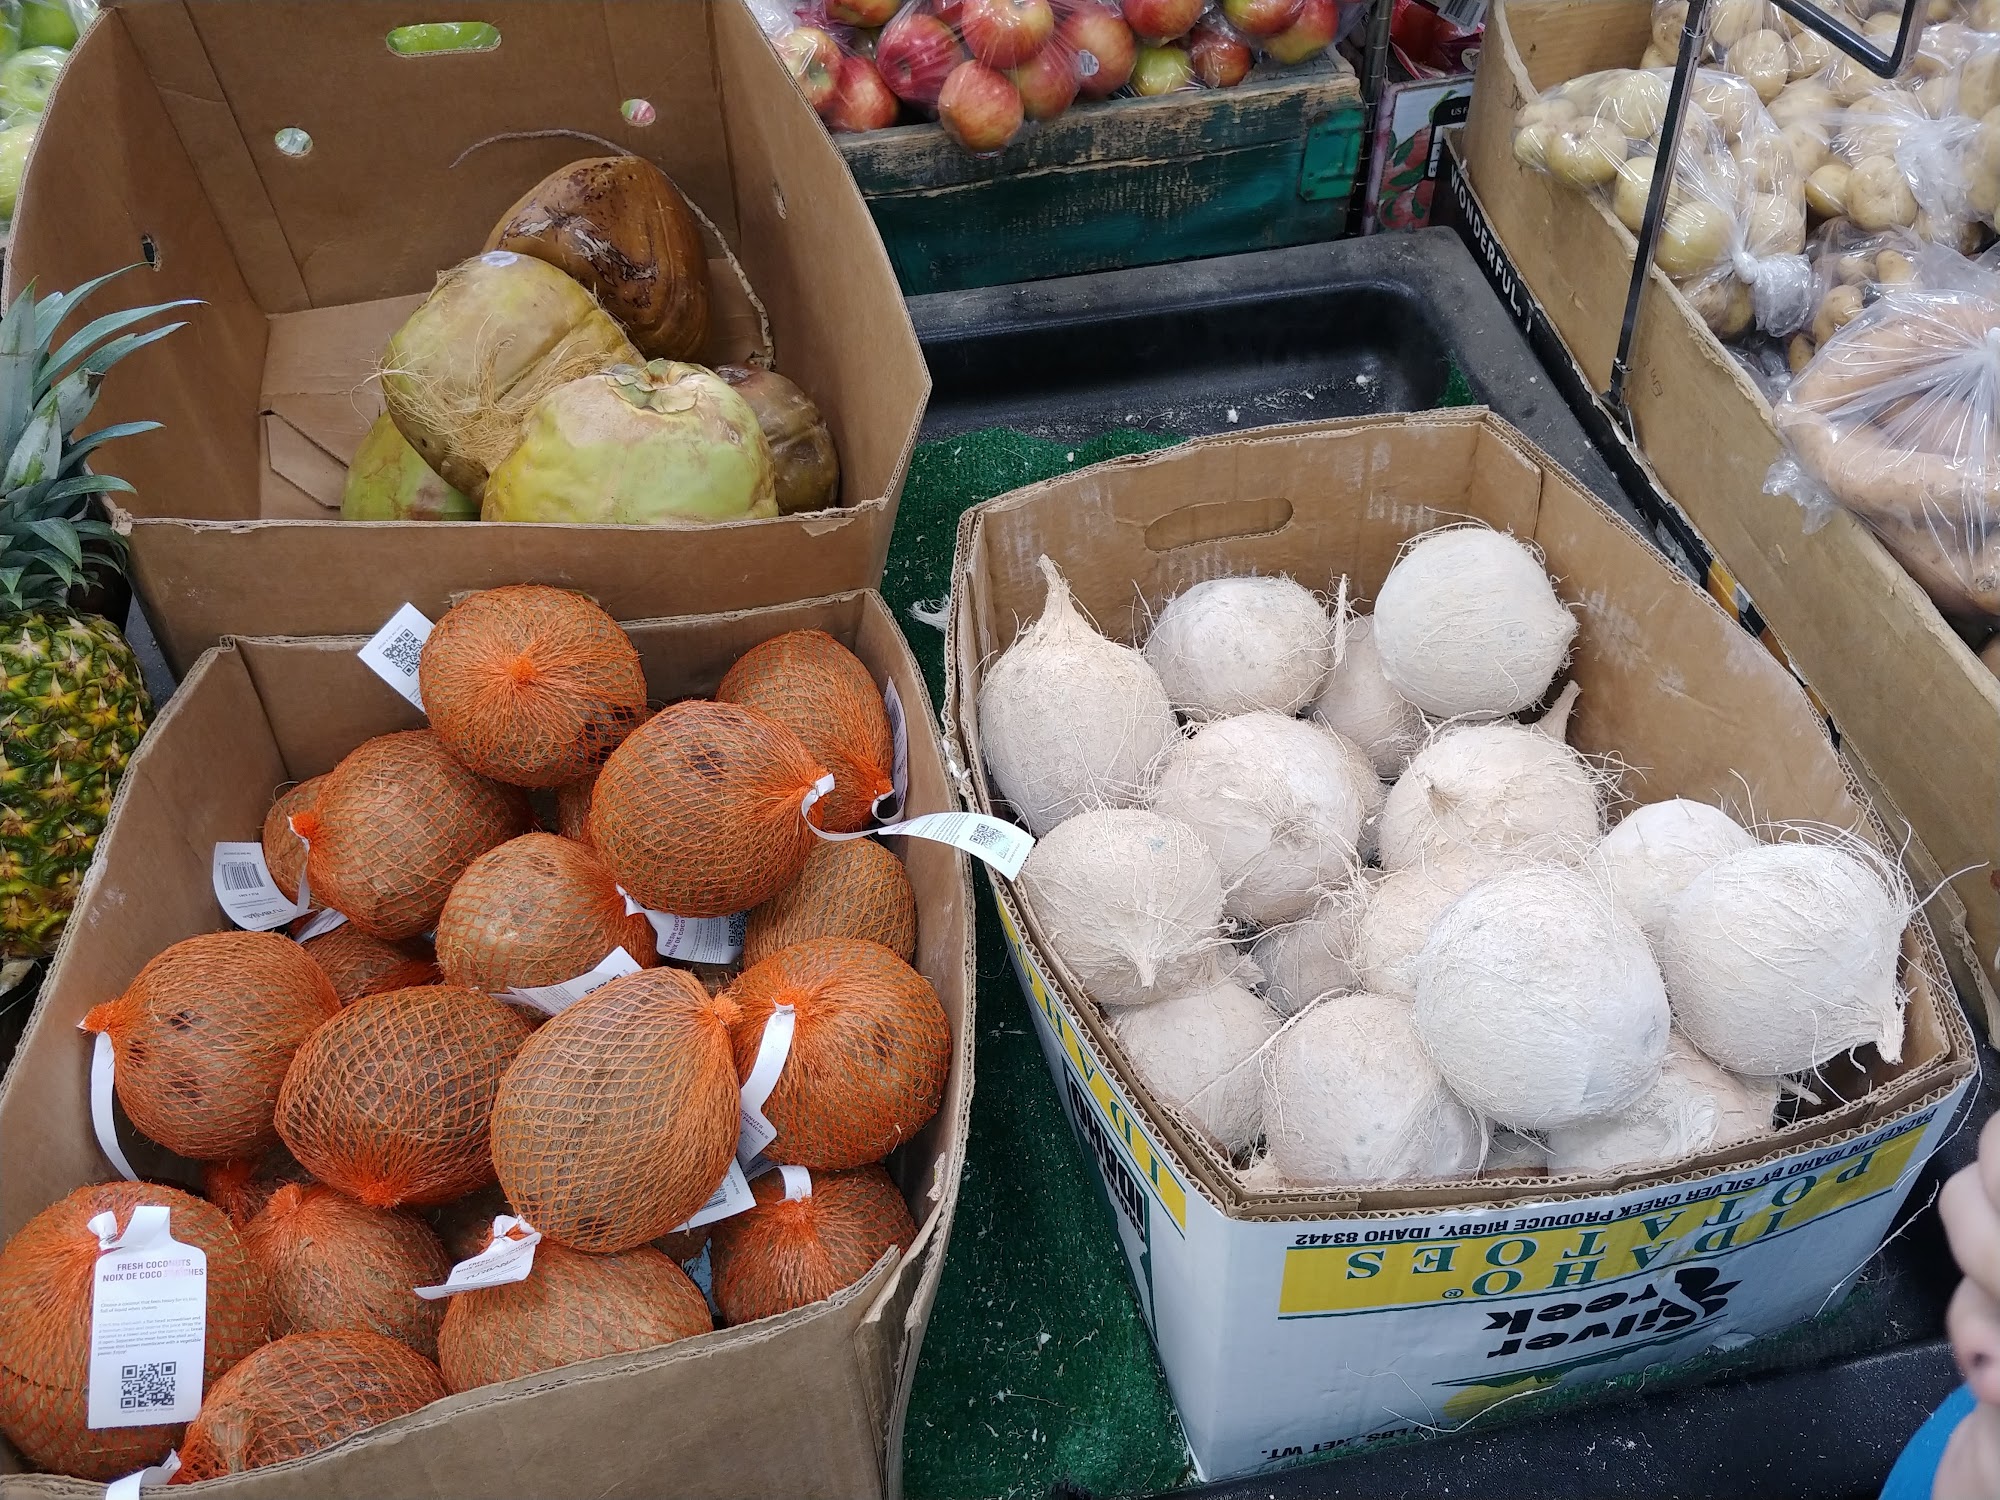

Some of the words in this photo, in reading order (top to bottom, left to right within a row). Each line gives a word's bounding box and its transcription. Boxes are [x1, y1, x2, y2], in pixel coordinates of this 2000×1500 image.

[1451, 164, 1518, 312] WONDERFUL
[1015, 938, 1163, 1193] IDAHO
[1871, 1107, 1939, 1146] PACKED
[1069, 1080, 1145, 1229] IDAHO
[1849, 1138, 1871, 1154] IN
[1787, 1150, 1845, 1175] IDAHO
[1757, 1167, 1786, 1185] BY
[1685, 1177, 1756, 1202] SILVER
[1346, 1148, 1881, 1280] POTATOES
[1616, 1193, 1682, 1218] CREEK
[1438, 1219, 1509, 1237] RIGBY,
[1513, 1209, 1614, 1230] PRODUCE
[1295, 1232, 1359, 1245] 83442
[1364, 1227, 1431, 1242] IDAHO
[102, 1273, 124, 1282] NOIX
[126, 1272, 138, 1280] DE
[139, 1270, 162, 1280] COCO
[117, 1262, 144, 1271] FRESH
[146, 1259, 191, 1269] COCOUTS
[1487, 1298, 1706, 1359] Silver
